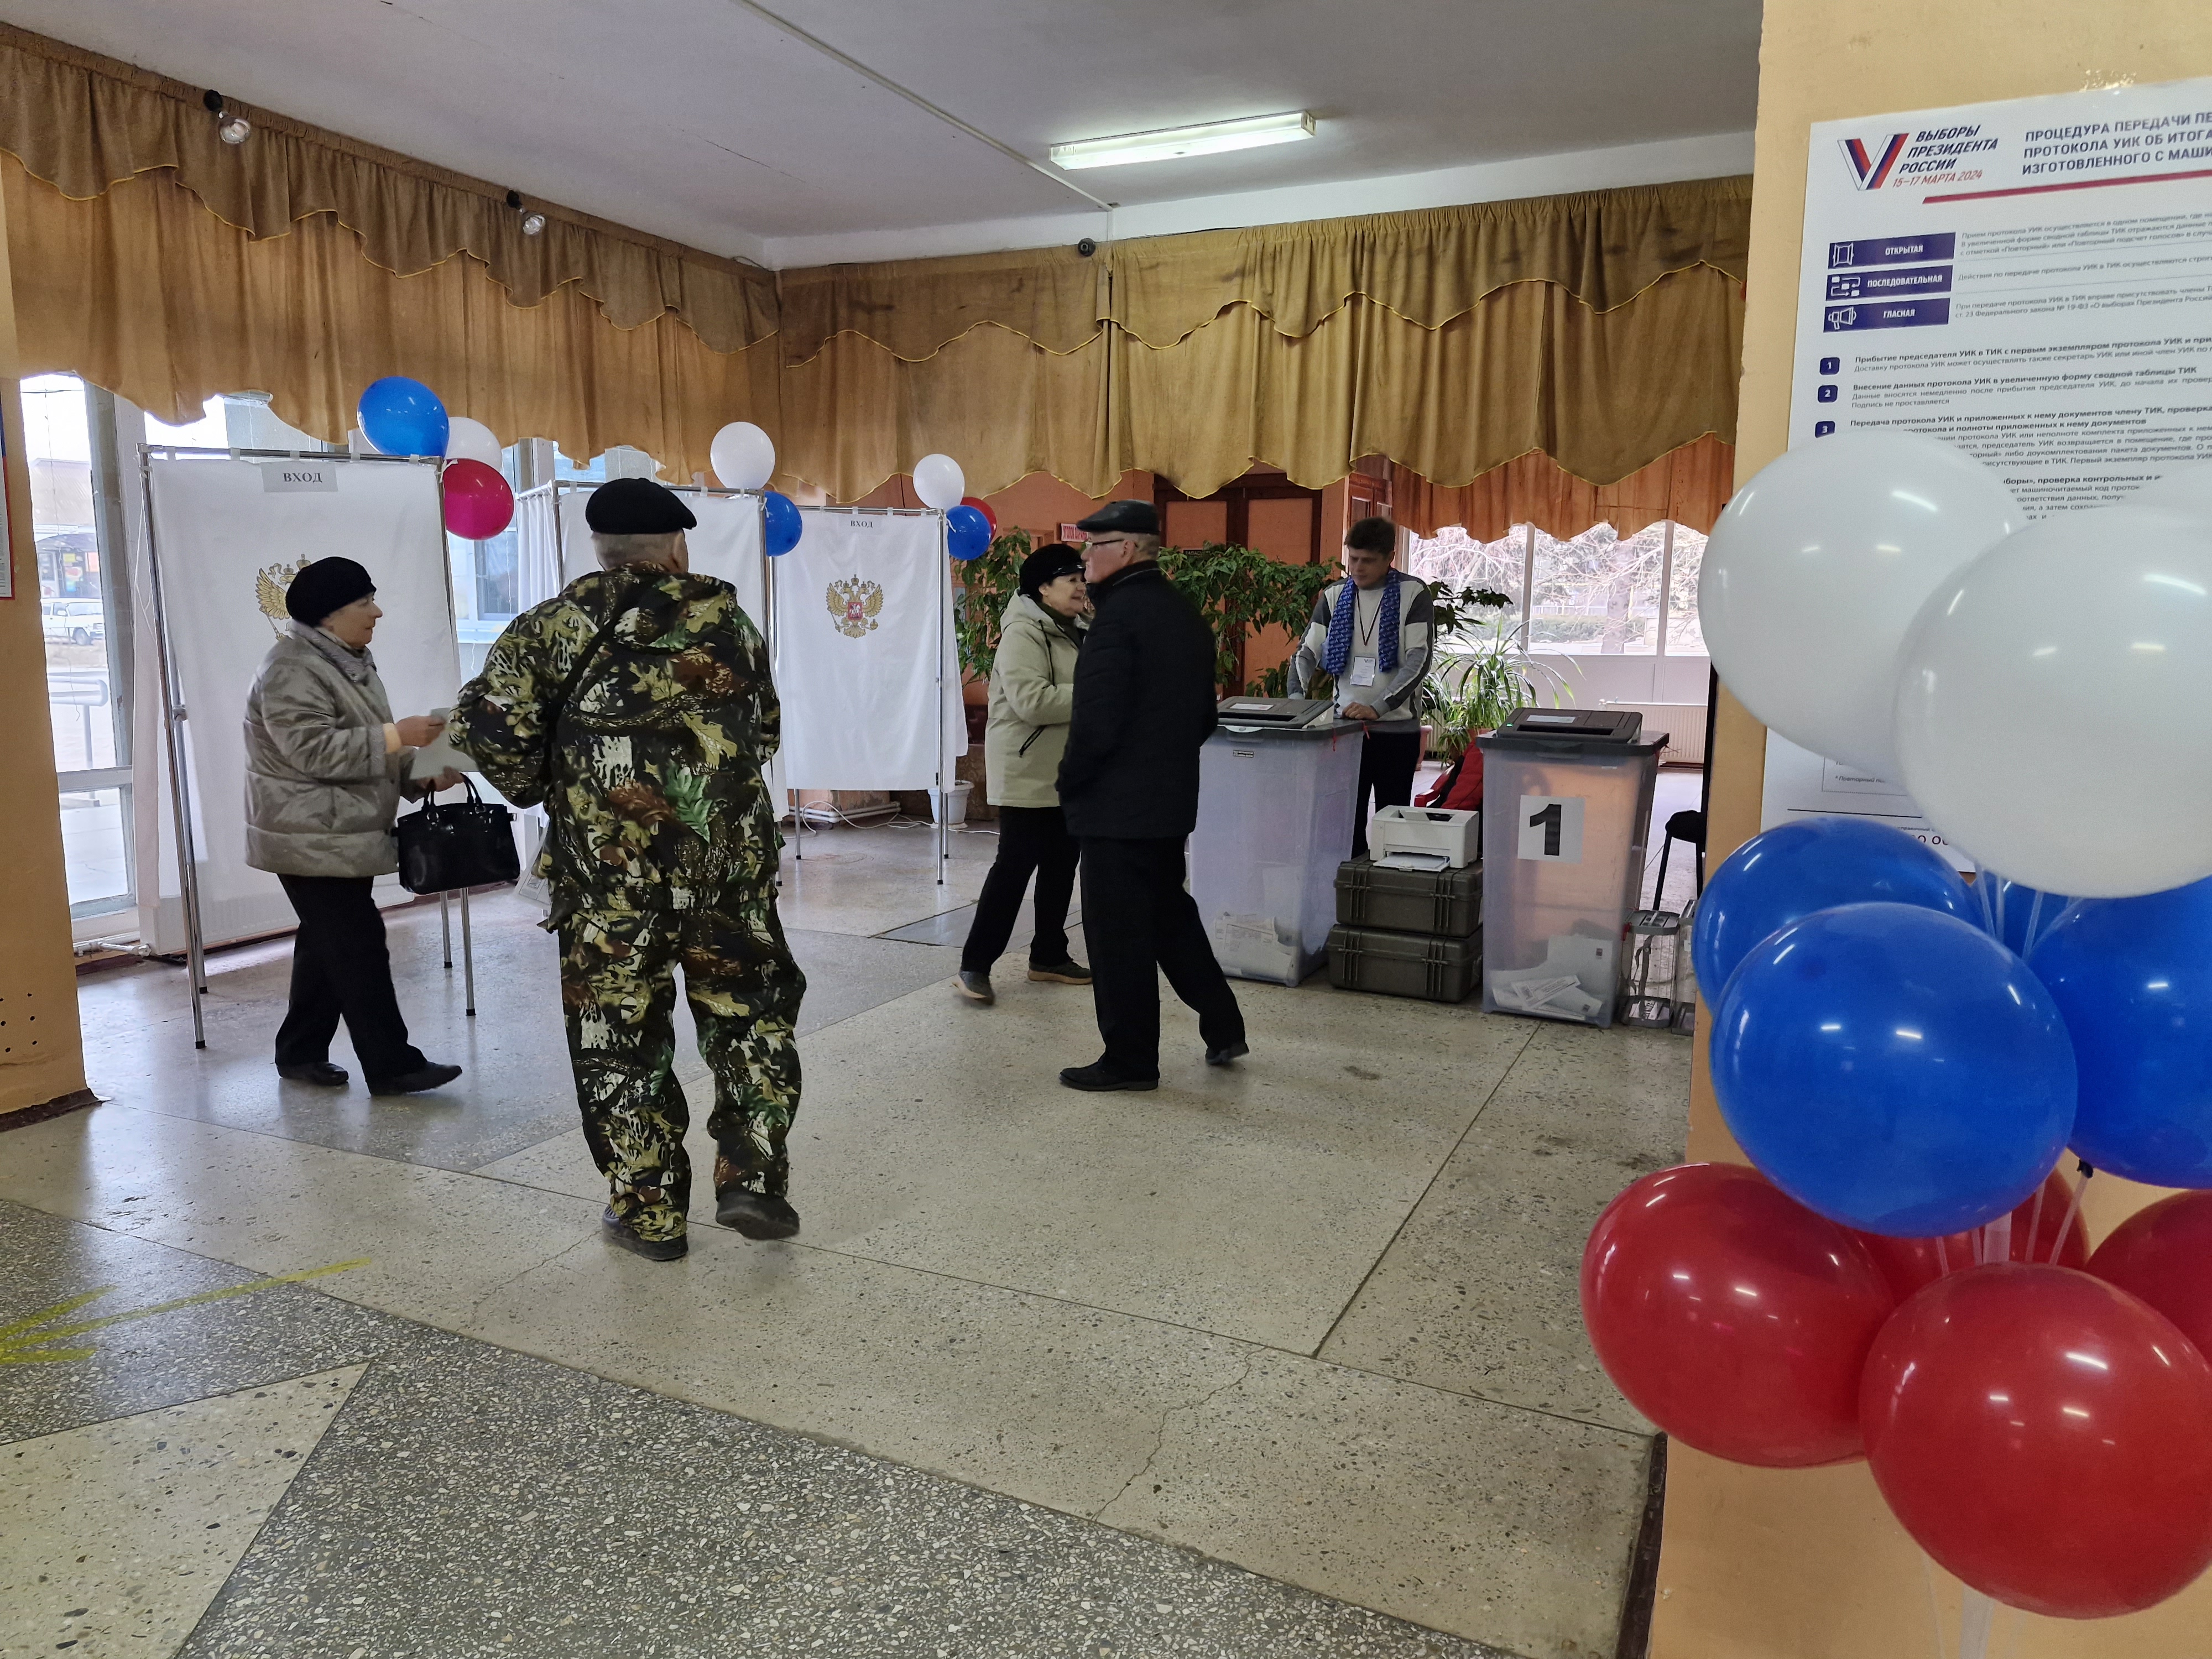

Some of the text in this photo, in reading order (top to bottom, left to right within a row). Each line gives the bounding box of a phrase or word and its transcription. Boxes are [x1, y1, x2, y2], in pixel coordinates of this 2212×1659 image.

[1916, 124, 1981, 143] ВЫБОРЫ
[2025, 123, 2110, 142] ПРОЦЕДУРА
[2114, 114, 2190, 132] ПЕРЕДАЧИ
[1907, 138, 1999, 159] ПРЕЗИДЕНТА
[2023, 139, 2107, 158] ПРОТОКОЛА
[2113, 136, 2141, 149] УИК
[2145, 134, 2163, 145] ОБ
[1898, 158, 1958, 174] РОССИИ
[2022, 152, 2150, 175] ИЗГОТОВЛЕННОГО
[2155, 151, 2163, 161] С
[1921, 173, 1956, 185] МАРТА
[1958, 169, 1983, 181] 2024
[1885, 244, 1923, 255] ОТКРЫТАЯ
[1867, 274, 1943, 288] ПОСЛЕДОВАТЕЛЬНАЯ
[1883, 309, 1916, 319] ГЛАСНАЯ
[1855, 356, 1897, 364] Прибытие
[1898, 353, 1957, 362] председателя
[2048, 343, 2109, 352] экземпляром
[2111, 340, 2161, 349] протокола
[1827, 362, 1832, 370] 1
[2000, 375, 2059, 384] увеличенную
[2094, 370, 2132, 378] сводной
[1824, 389, 1831, 398] 2
[1964, 414, 2025, 423] приложенных
[1822, 425, 1828, 434] 3
[1995, 423, 2057, 431] приложенных
[283, 472, 323, 484] ВХОД
[1529, 804, 1562, 855] 1
